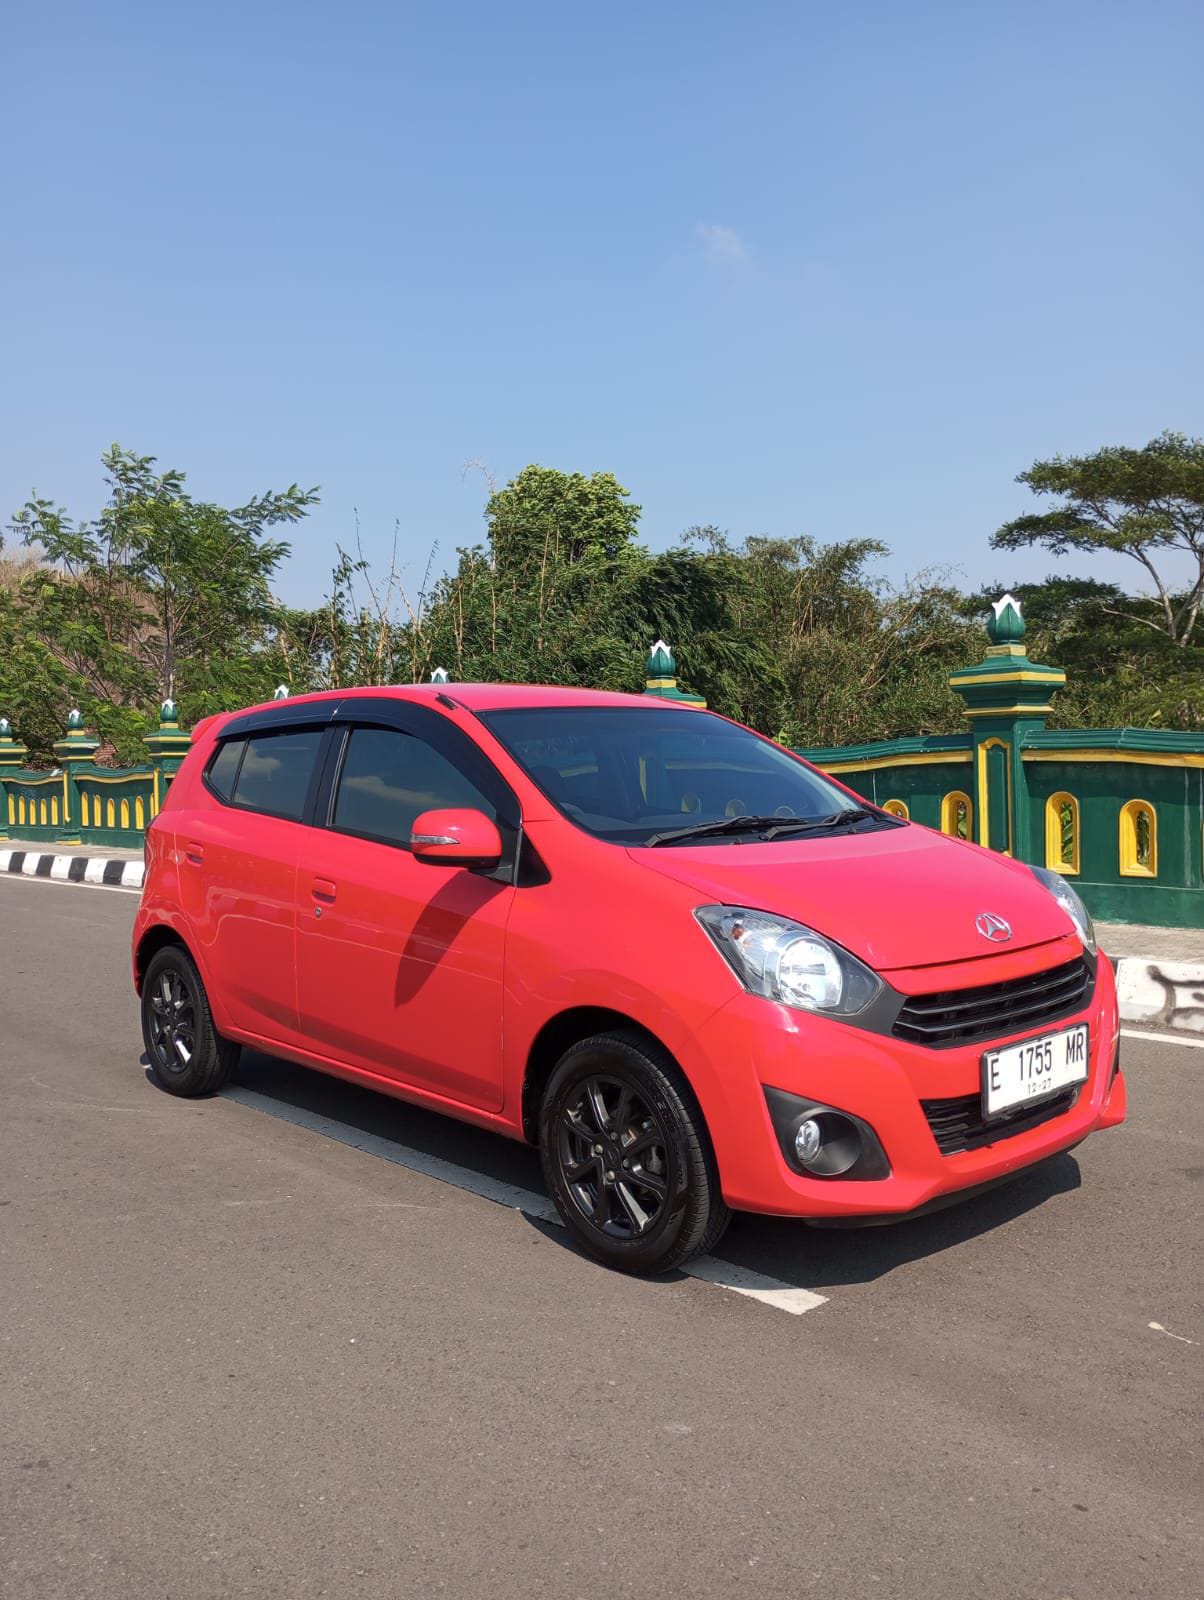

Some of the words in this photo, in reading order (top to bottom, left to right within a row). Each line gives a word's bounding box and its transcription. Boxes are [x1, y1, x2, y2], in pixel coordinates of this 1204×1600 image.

[991, 1058, 1001, 1092] E
[1019, 1041, 1052, 1081] 1755
[1066, 1032, 1084, 1065] MR
